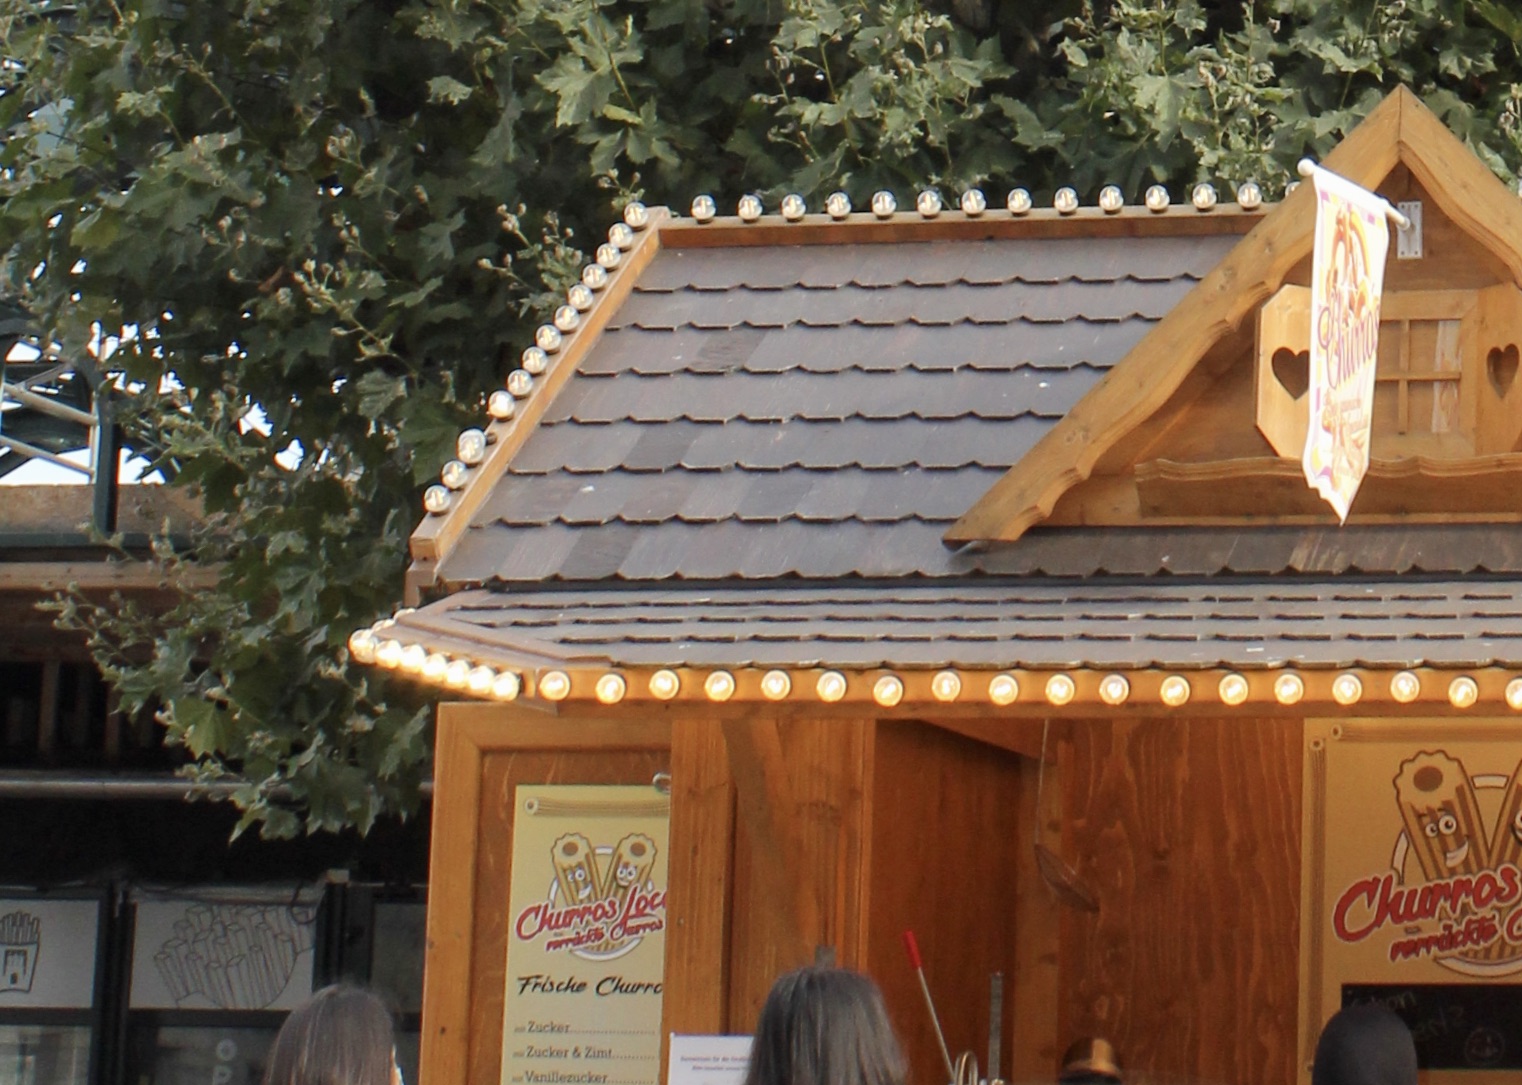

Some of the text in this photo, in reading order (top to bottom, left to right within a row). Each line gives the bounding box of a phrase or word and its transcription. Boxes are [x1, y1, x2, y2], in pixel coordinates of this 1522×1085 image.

[515, 886, 667, 941] Churros Loc
[1333, 866, 1519, 943] Churros
[610, 919, 663, 941] Churros
[517, 974, 663, 996] Frische Churro
[528, 1021, 571, 1034] Zucker
[526, 1046, 570, 1059] Zucker
[571, 1047, 582, 1059] &
[584, 1046, 612, 1059] Zimt
[525, 1071, 608, 1084] Vanillezucker
